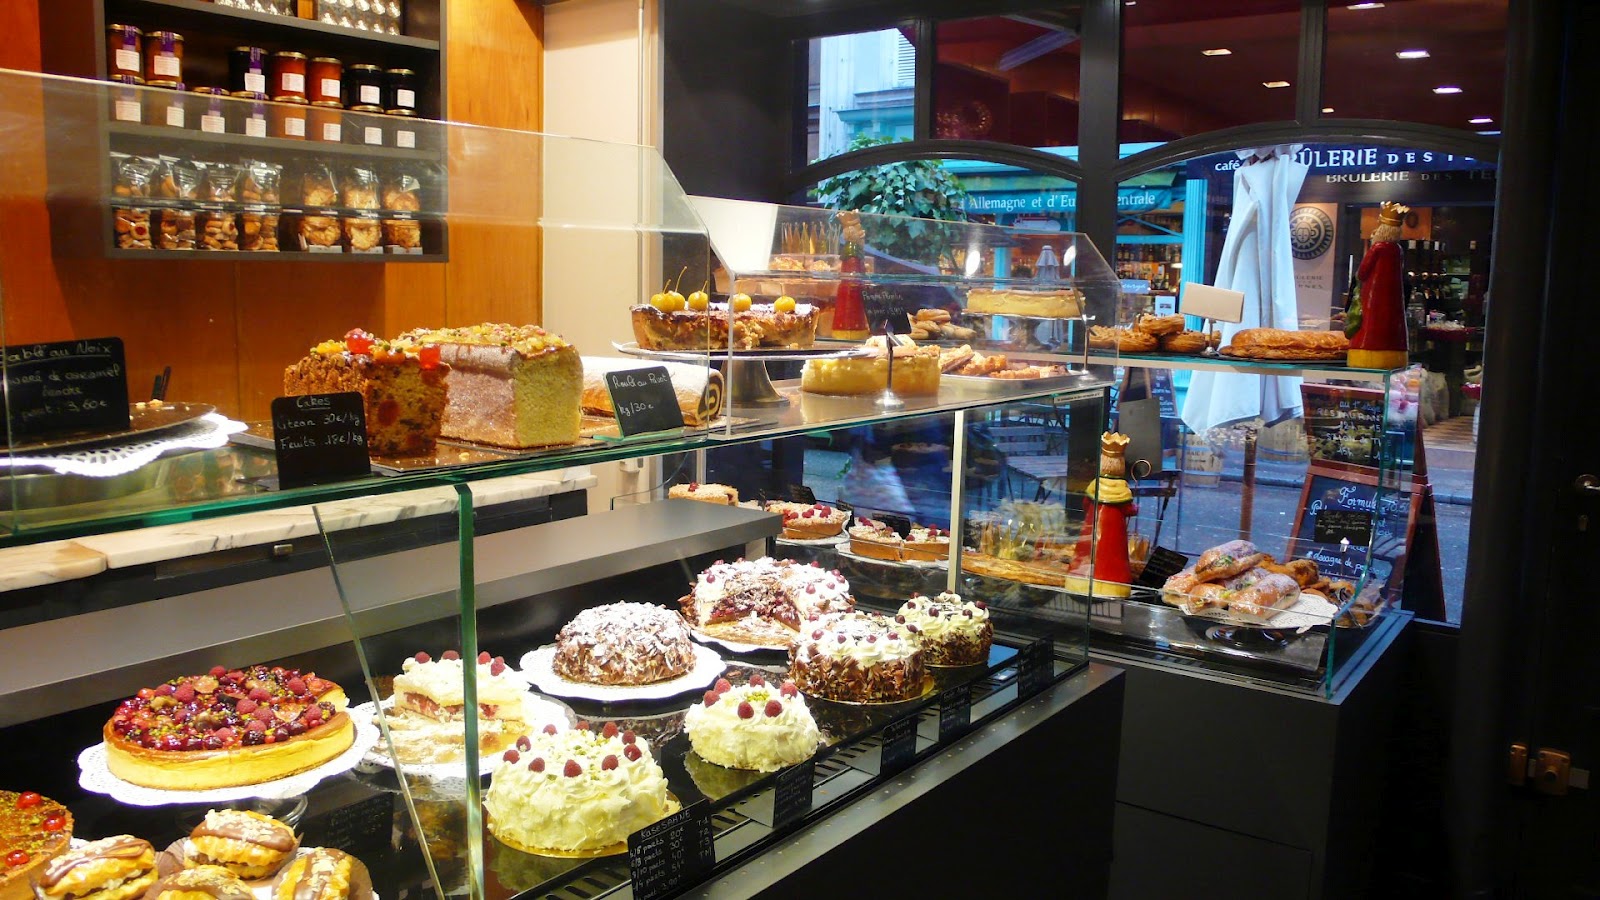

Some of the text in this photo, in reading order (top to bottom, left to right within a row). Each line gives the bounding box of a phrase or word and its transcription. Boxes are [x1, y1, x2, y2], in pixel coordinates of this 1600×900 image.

[1214, 159, 1240, 171] café
[1387, 151, 1433, 164] DES
[1031, 196, 1042, 208] et
[1047, 194, 1077, 208] d'Eu
[1116, 191, 1156, 206] entrale
[49, 347, 70, 358] au
[76, 340, 112, 354] Noix
[296, 395, 332, 408] Cakes
[279, 433, 317, 450] Fruits
